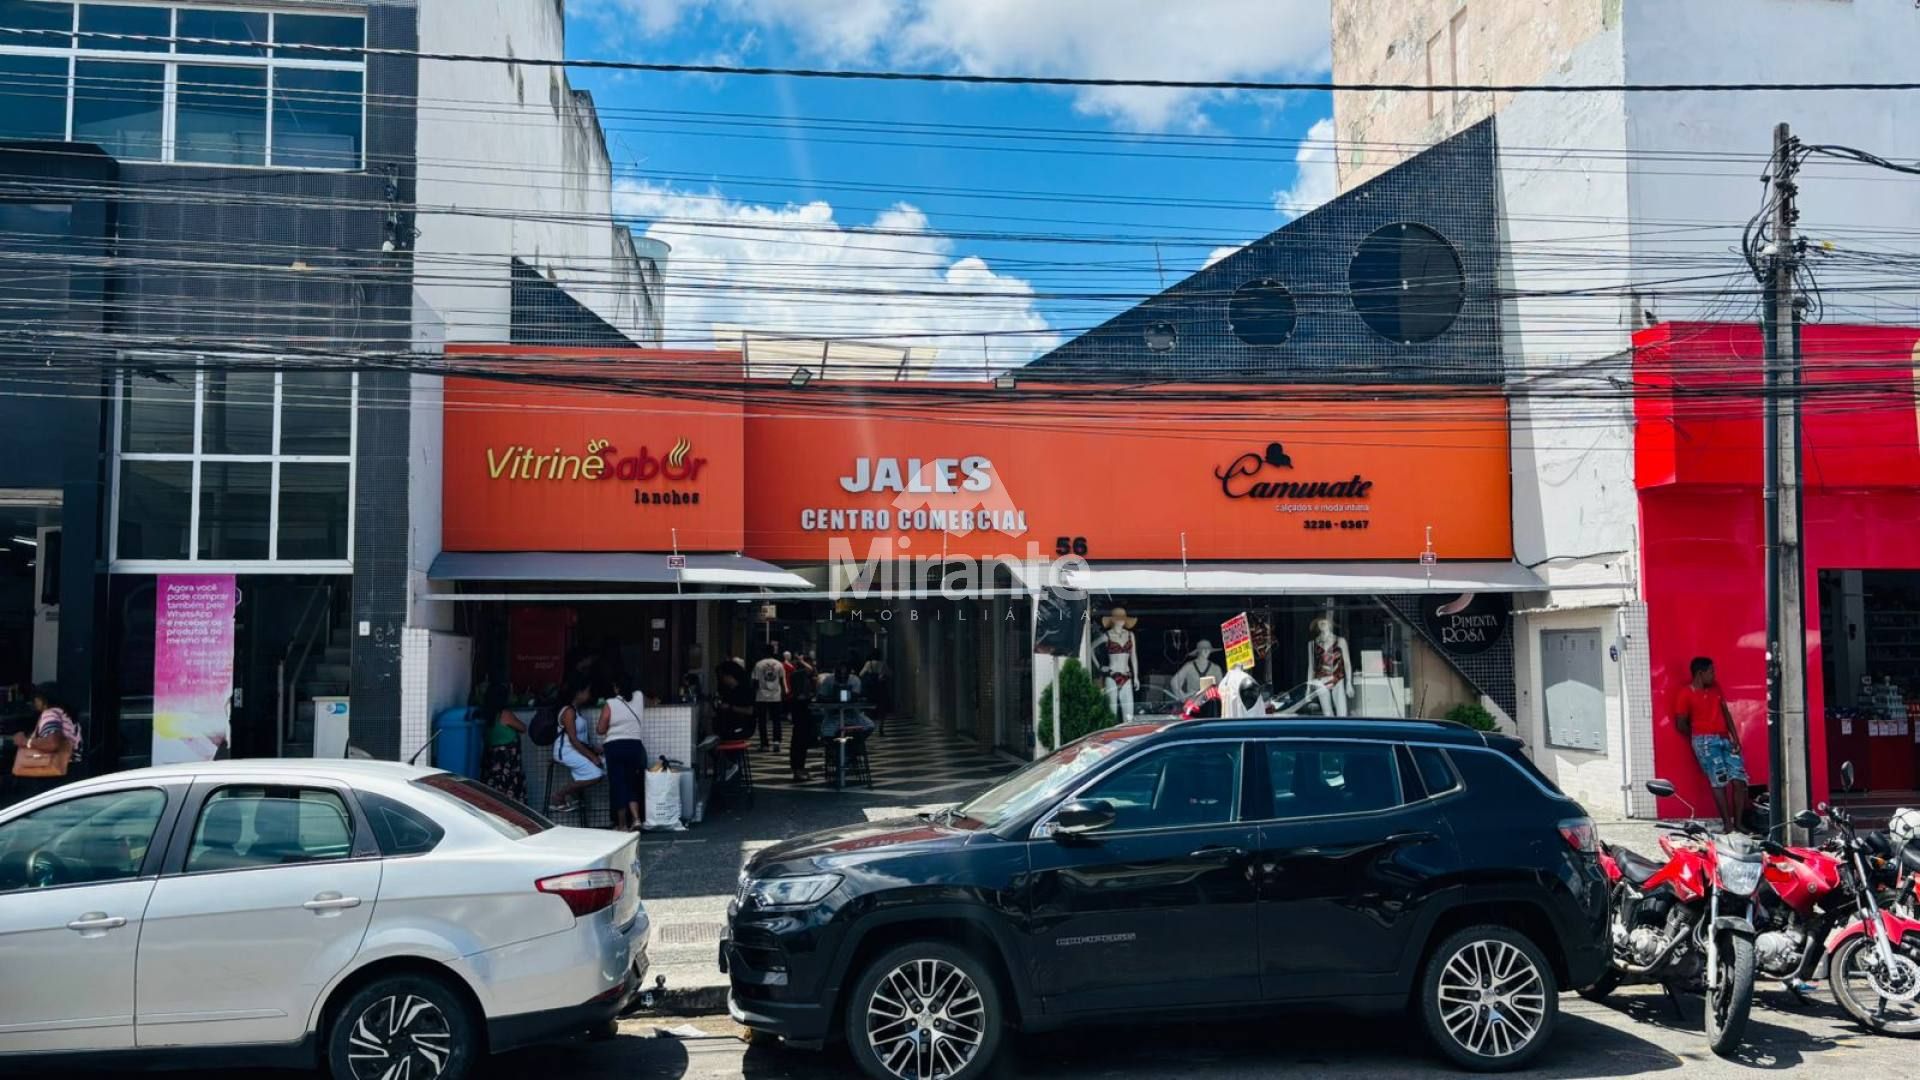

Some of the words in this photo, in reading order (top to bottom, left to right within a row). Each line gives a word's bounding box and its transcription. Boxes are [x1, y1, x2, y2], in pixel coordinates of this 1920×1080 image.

[487, 446, 604, 480] Vitrine
[839, 456, 992, 494] JALES
[634, 488, 700, 505] lanches
[1320, 503, 1344, 512] moda
[801, 508, 890, 531] CENTRO
[897, 509, 1028, 532] COMERCIAL
[1055, 537, 1088, 556] 56
[167, 583, 194, 594] Agora
[196, 583, 218, 591] você
[167, 593, 191, 601] pode
[192, 594, 229, 603] comprar
[167, 601, 204, 609] também
[206, 602, 225, 610] pelo
[167, 611, 213, 620] WhatsApp
[1451, 615, 1498, 628] PIMENTA
[1441, 627, 1486, 643] ROSA
